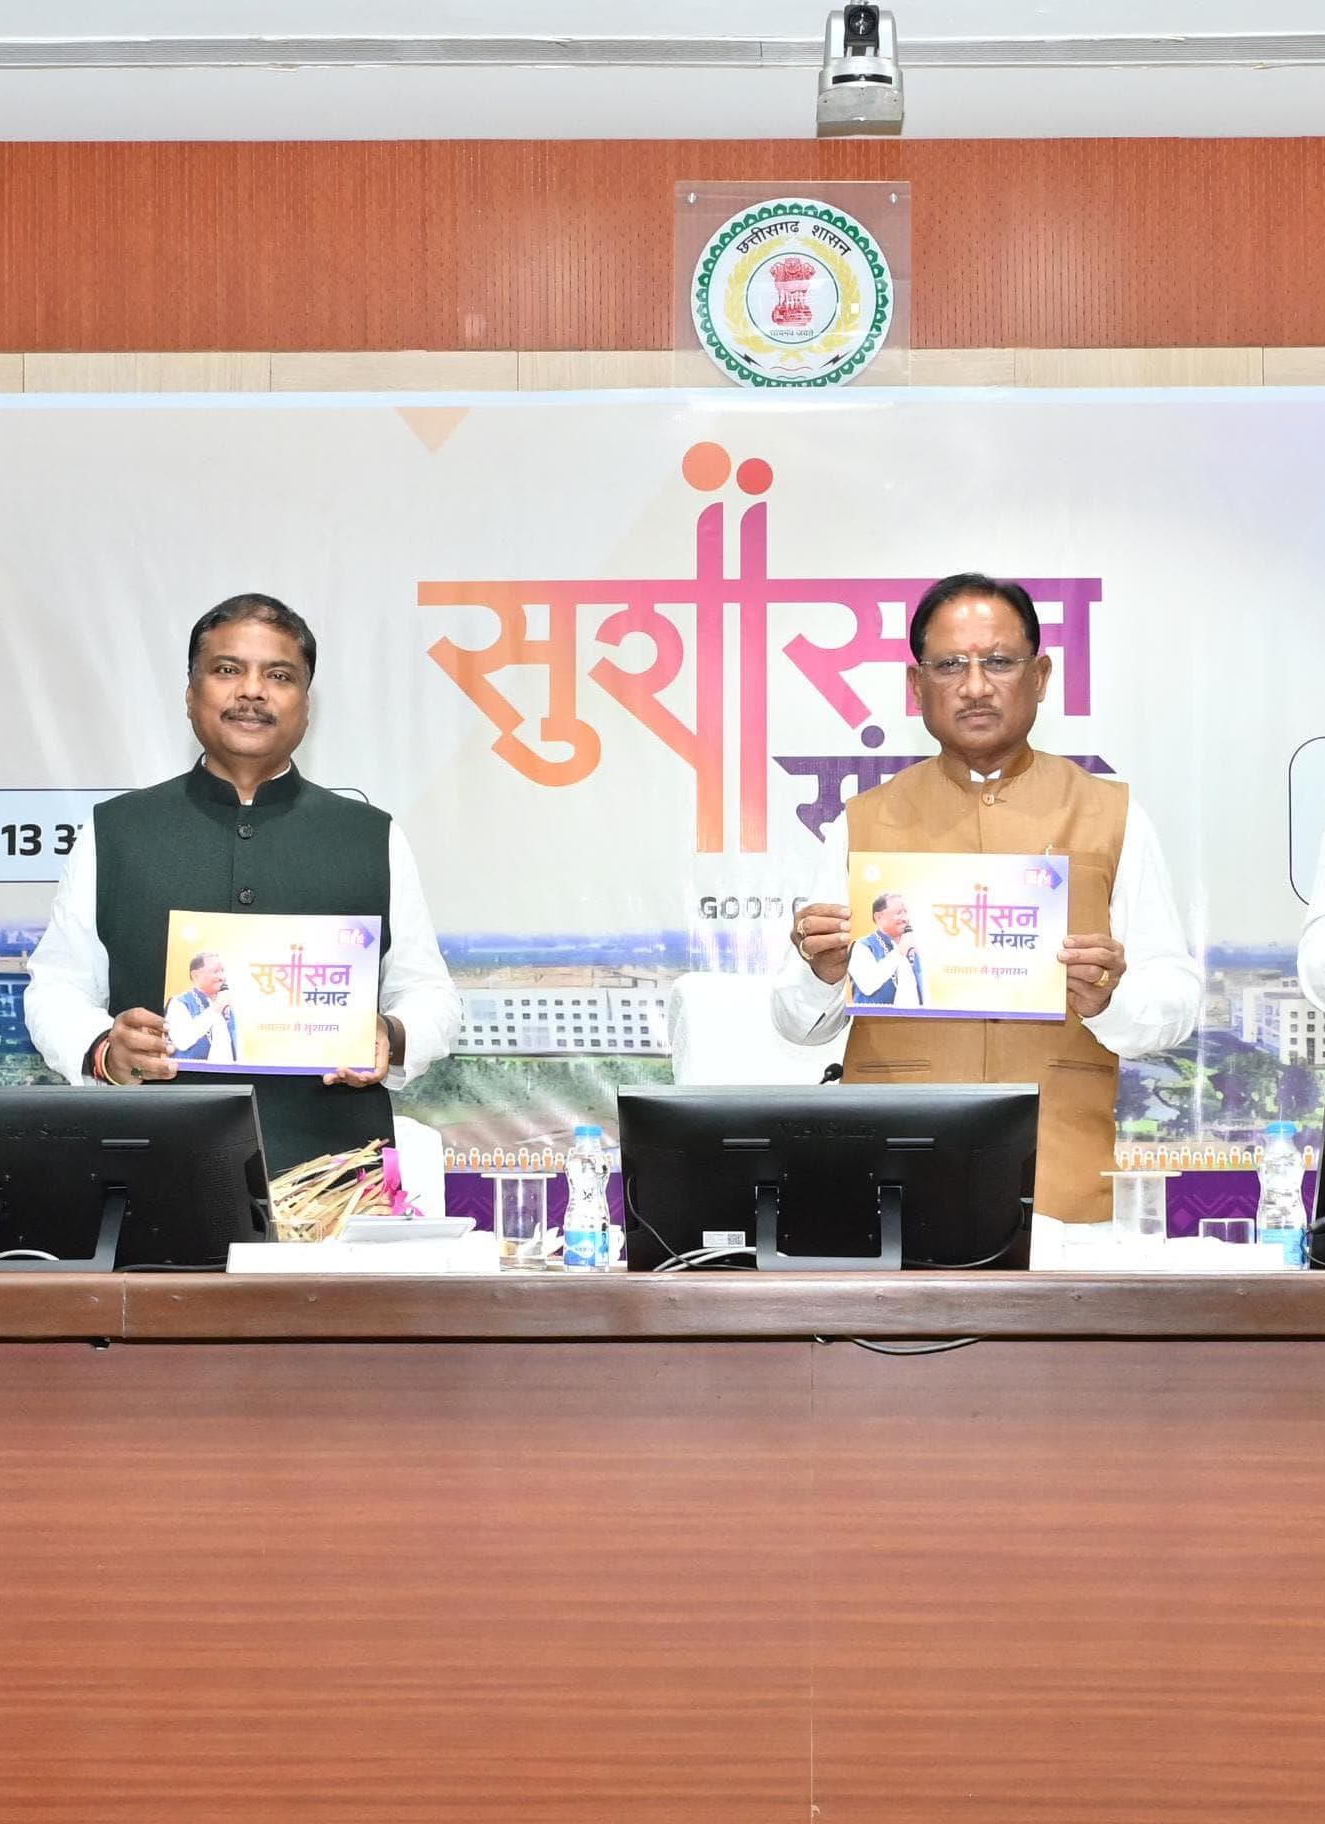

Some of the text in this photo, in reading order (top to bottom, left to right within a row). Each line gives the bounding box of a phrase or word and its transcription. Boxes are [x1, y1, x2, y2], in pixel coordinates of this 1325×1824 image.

[811, 224, 852, 256] शासन
[1, 823, 42, 856] 13
[931, 883, 1040, 949] सुशासन
[989, 930, 1039, 950] संवाद
[249, 944, 352, 1007] सुशासन
[303, 988, 351, 1007] संवाद
